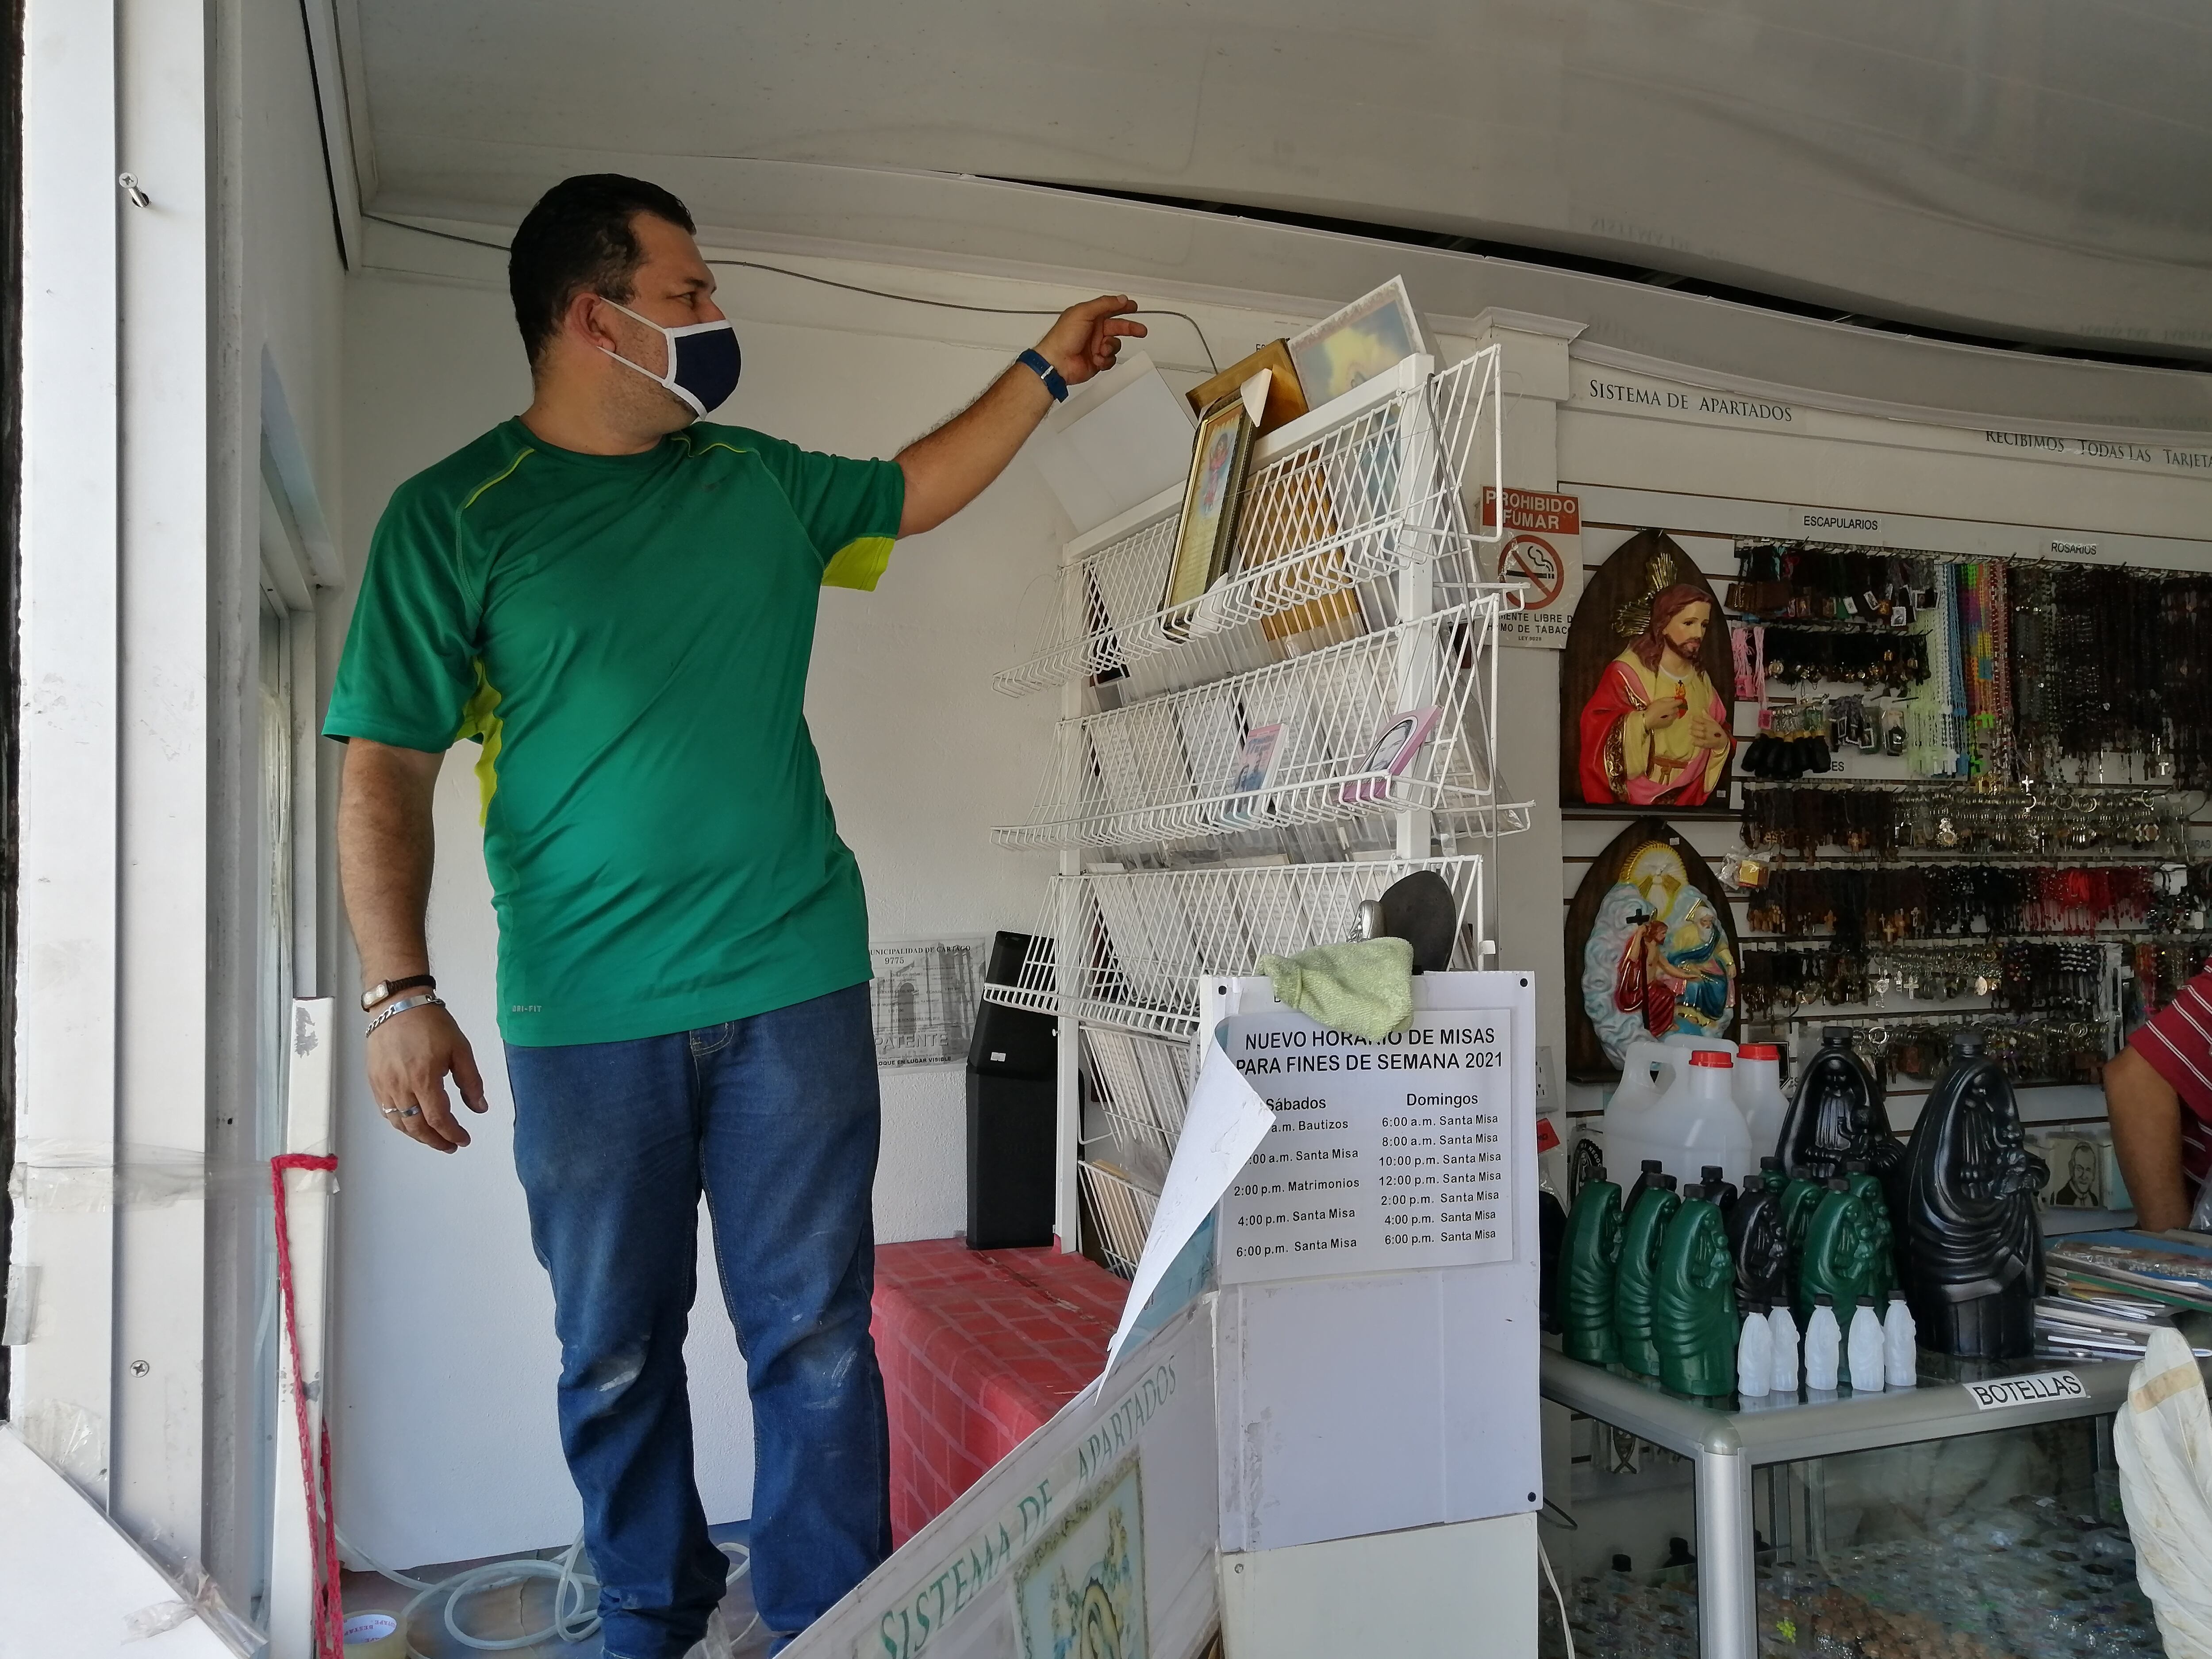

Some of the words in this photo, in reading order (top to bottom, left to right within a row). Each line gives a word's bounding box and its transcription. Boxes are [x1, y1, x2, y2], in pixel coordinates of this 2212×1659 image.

[1590, 380, 1661, 406] SISTEMA
[1667, 392, 1689, 409] DE
[1699, 397, 1792, 422] APARTADOS
[1986, 430, 2064, 452] RECIBIMOS
[2078, 439, 2124, 459] TODAS
[2129, 445, 2151, 462] LAS
[1502, 509, 1559, 530] FUMAR
[1804, 515, 1878, 530] ESCAPULARIOS
[2051, 542, 2097, 555] ROSARIOS
[1534, 614, 1563, 623] LIBRE
[1487, 622, 1513, 632] HMO
[1518, 624, 1530, 633] DE
[874, 1033, 949, 1050] PATENTE
[1246, 1031, 1306, 1050] NUEVO
[1409, 1029, 1434, 1045] DE
[1440, 1028, 1495, 1045] MISAS
[1236, 1057, 1282, 1075] PARA
[1286, 1055, 1340, 1073] FINES
[1346, 1054, 1371, 1071] DE
[1377, 1053, 1460, 1070] SEMANA
[1465, 1051, 1502, 1068] 2021
[1266, 1096, 1326, 1111] Sábados
[1406, 1093, 1479, 1108] Domingos
[1271, 1124, 1295, 1133] a.m.
[1298, 1119, 1348, 1131] Bautizos
[1382, 1117, 1408, 1127] 6:00
[1439, 1115, 1473, 1125] Santa
[1475, 1114, 1498, 1124] Misa
[1382, 1136, 1408, 1147] 8:00
[1439, 1135, 1473, 1144] Santa
[1475, 1133, 1498, 1144] Misa
[1269, 1154, 1293, 1163] a.m.
[1296, 1150, 1329, 1161] Santa
[1332, 1148, 1359, 1159] Misa
[1379, 1156, 1411, 1167] 10:00
[1415, 1157, 1440, 1167] p.m.
[1443, 1154, 1476, 1164] Santa
[1479, 1152, 1502, 1162] Misa
[1379, 1175, 1411, 1186] 12:00
[1415, 1176, 1440, 1187] p.m.
[1443, 1173, 1476, 1183] Santa
[1479, 1171, 1502, 1182] Misa
[1234, 1184, 1258, 1196] 2:00
[1261, 1184, 1285, 1197] p.m.
[1288, 1178, 1359, 1192] Matrimonios
[1381, 1195, 1406, 1206] 2:00
[1409, 1195, 1434, 1207] p.m.
[1440, 1193, 1474, 1203] Santa
[1476, 1190, 1499, 1201] Misa
[1238, 1215, 1262, 1226] 4:00
[1266, 1215, 1289, 1227] p.m.
[1293, 1210, 1326, 1221] Santa
[1329, 1208, 1356, 1219] Misa
[1384, 1214, 1408, 1225] 4:00
[1412, 1215, 1434, 1226] p.m.
[1440, 1212, 1472, 1222] Santa
[1475, 1210, 1496, 1221] Misa
[1385, 1234, 1408, 1245] 6:00
[1412, 1235, 1434, 1246] p.m.
[1440, 1232, 1472, 1242] Santa
[1475, 1229, 1496, 1240] Misa
[1236, 1245, 1261, 1257] 6:00
[1264, 1245, 1288, 1257] p.m.
[1294, 1240, 1328, 1252] Santa
[1330, 1238, 1357, 1249] Misa
[1972, 1375, 2081, 1406] BOTELLAS
[880, 1521, 1011, 1659] SISTEMA
[1017, 1478, 1054, 1548] DE
[1075, 1355, 1176, 1494] APARTADOS
